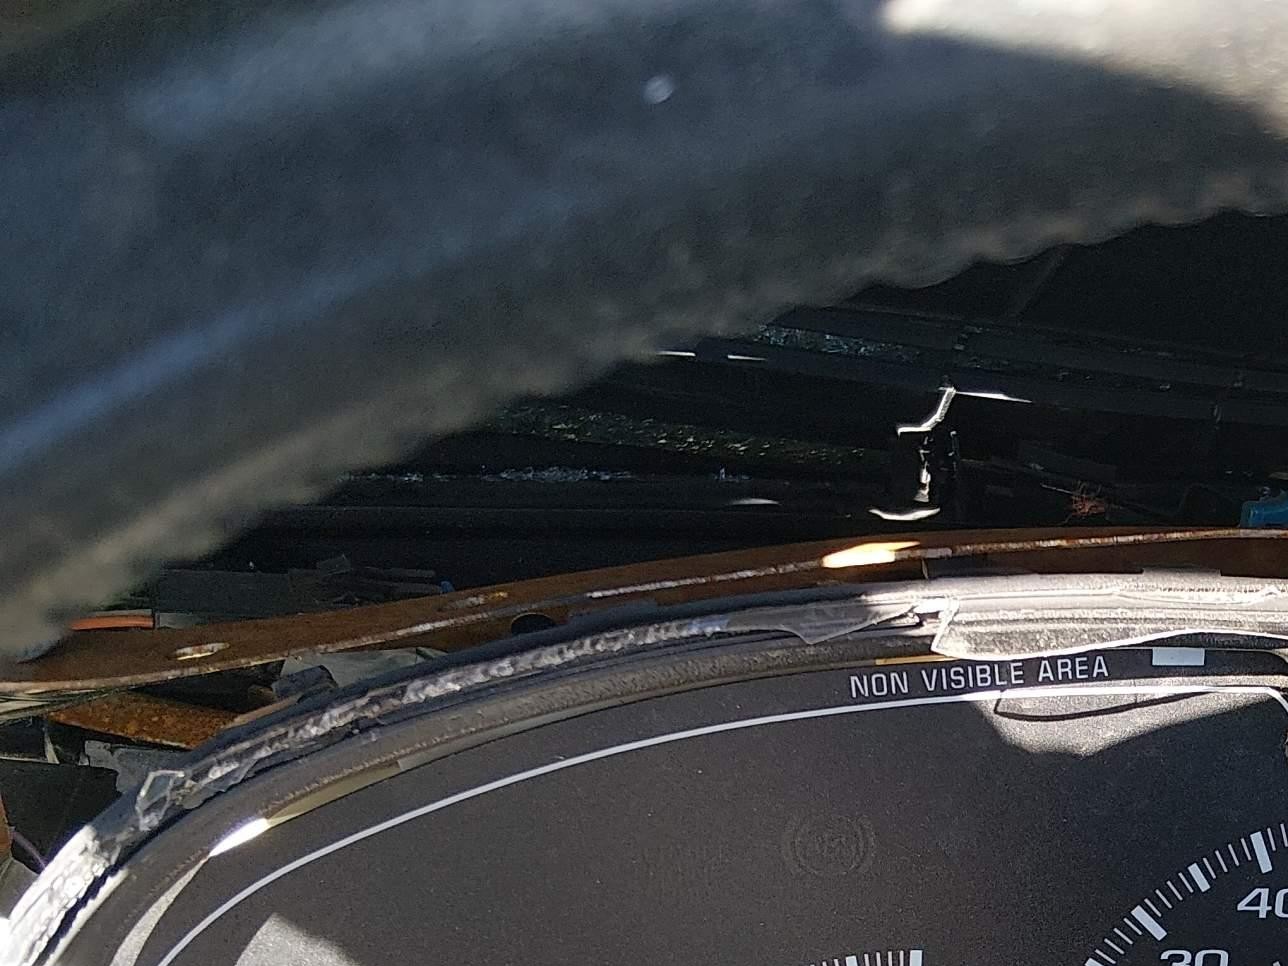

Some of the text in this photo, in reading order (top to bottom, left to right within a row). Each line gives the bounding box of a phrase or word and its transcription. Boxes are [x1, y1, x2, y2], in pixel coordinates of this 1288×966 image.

[850, 655, 1109, 699] NON VISIBLE AREA
